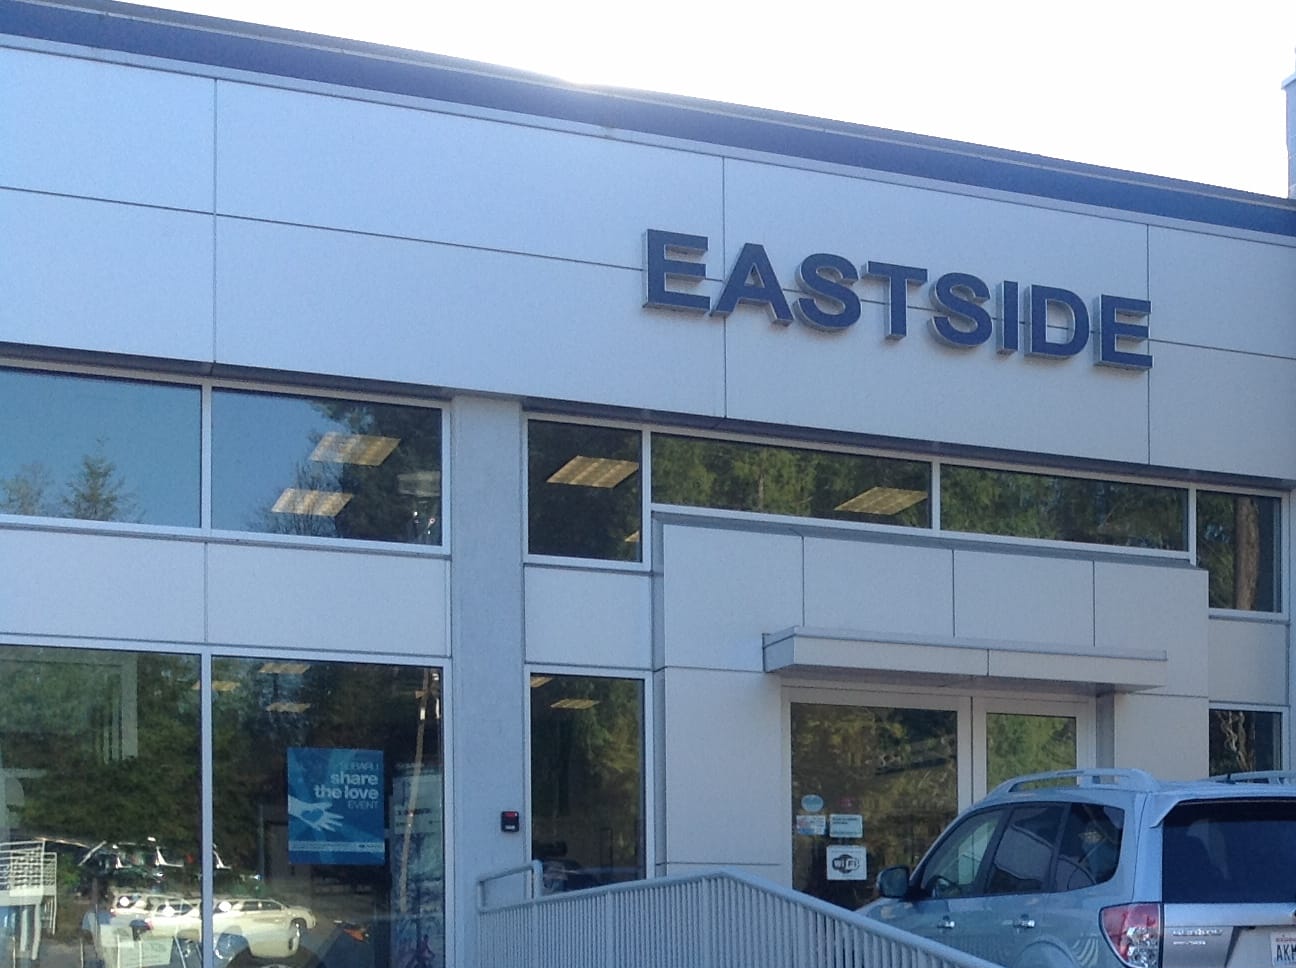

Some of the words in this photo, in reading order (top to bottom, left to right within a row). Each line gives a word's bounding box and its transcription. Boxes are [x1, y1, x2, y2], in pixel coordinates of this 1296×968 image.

[643, 229, 1154, 370] EASTSIDE
[330, 770, 379, 786] share
[313, 784, 343, 799] the
[344, 784, 379, 800] love
[347, 799, 379, 809] EVENT
